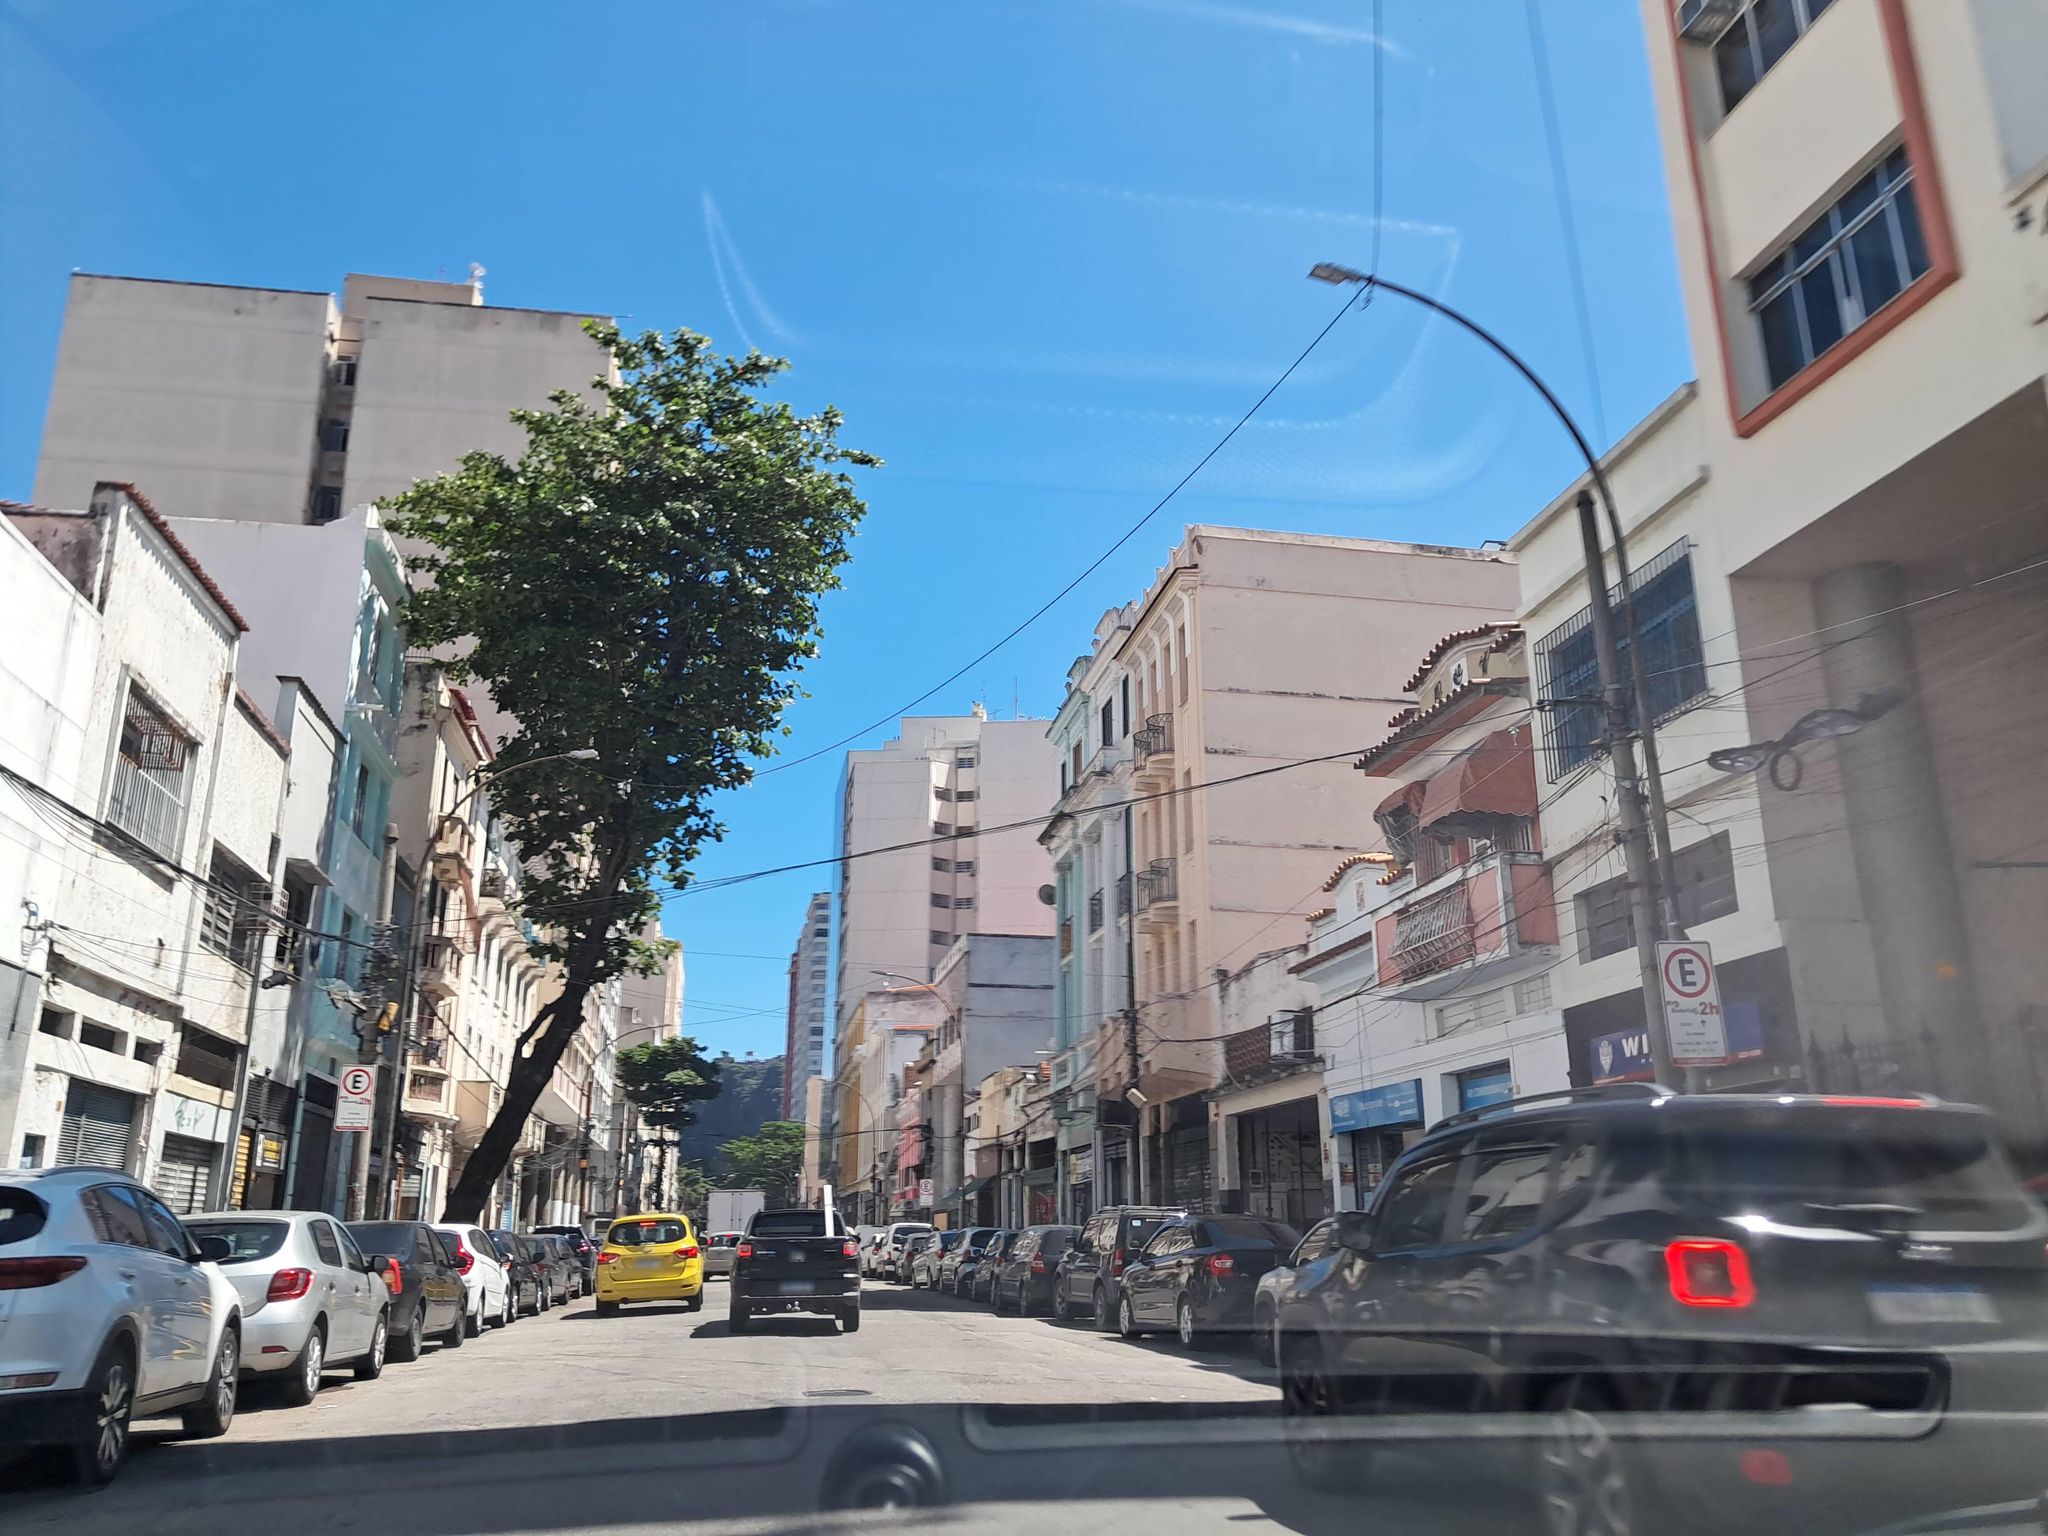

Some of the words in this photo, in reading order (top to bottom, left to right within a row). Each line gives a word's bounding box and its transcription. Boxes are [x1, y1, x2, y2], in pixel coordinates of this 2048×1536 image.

[1678, 958, 1697, 987] E
[1699, 1002, 1720, 1015] 2h
[1621, 1033, 1648, 1057] WI
[352, 1074, 363, 1089] E
